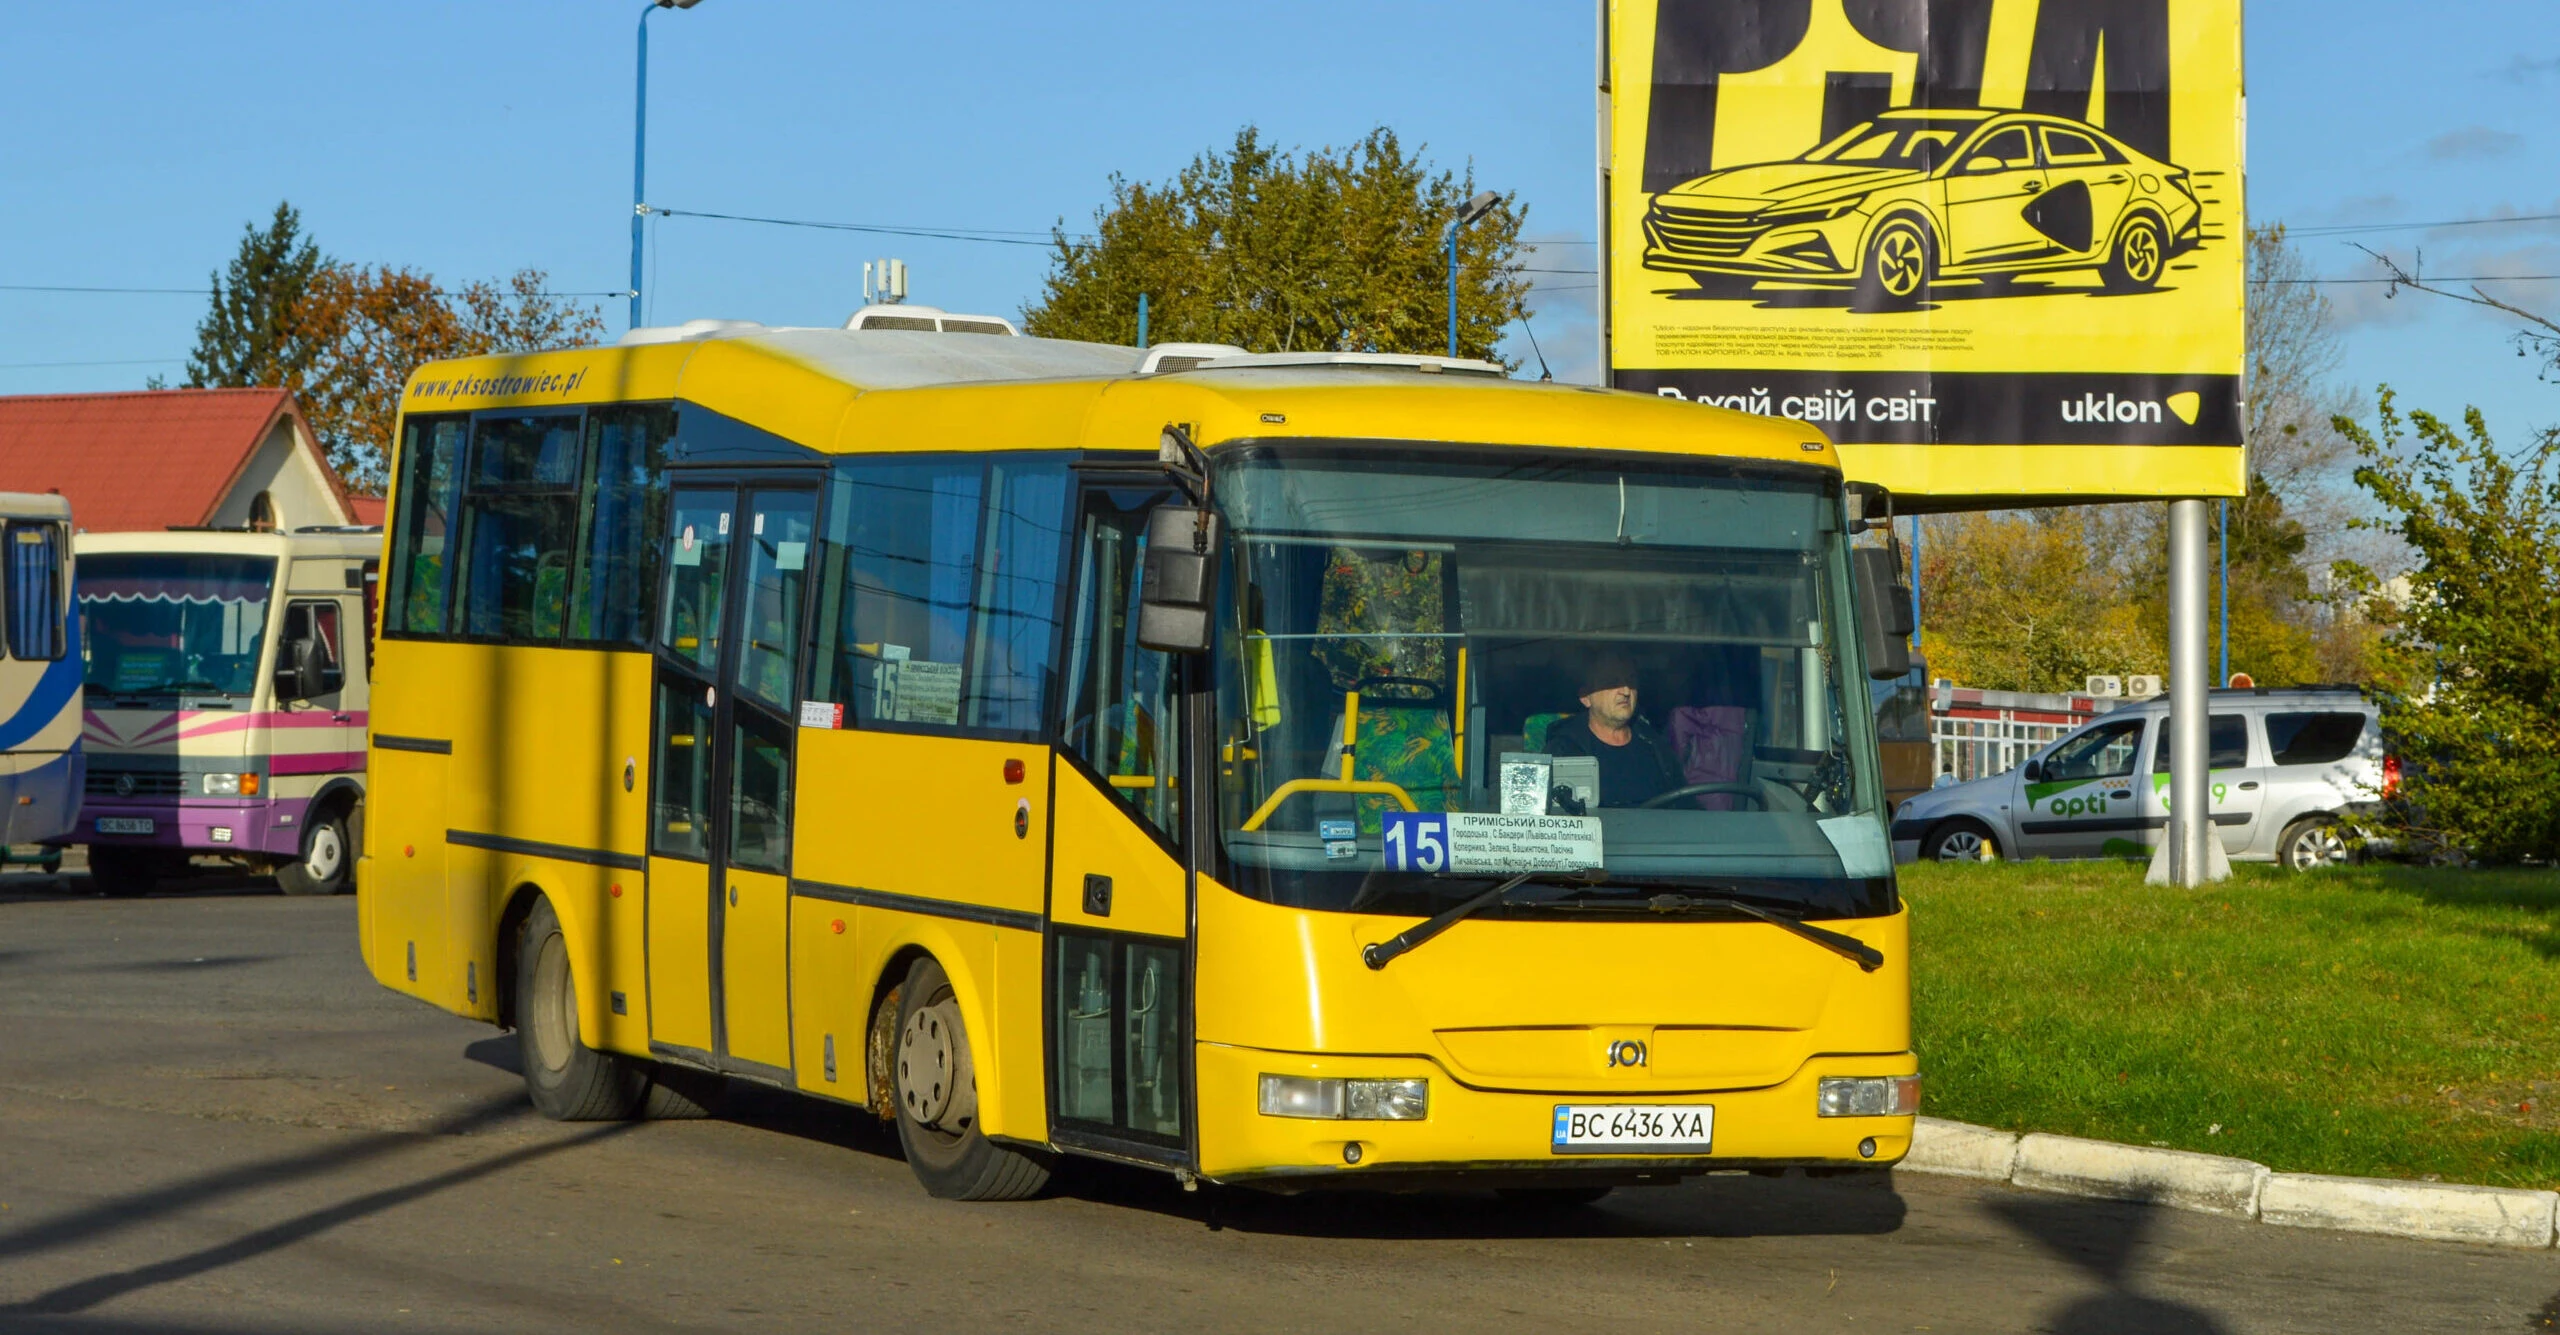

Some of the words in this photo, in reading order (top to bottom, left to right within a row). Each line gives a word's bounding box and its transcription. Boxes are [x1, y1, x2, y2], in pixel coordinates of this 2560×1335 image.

[413, 366, 589, 402] www.pksostrowiec.pl
[1780, 389, 1856, 422] свій
[1866, 389, 1937, 422] світ
[2061, 392, 2162, 423] uklon
[872, 661, 898, 721] 15
[2051, 792, 2107, 818] opti
[1463, 815, 1536, 828] ПРИМІСЬКИЙ
[1539, 818, 1583, 829] ВОКЗАЛ
[1386, 820, 1444, 872] 15
[1571, 1112, 1605, 1138] BC
[1610, 1111, 1664, 1138] 6436
[1670, 1112, 1705, 1138] XA
